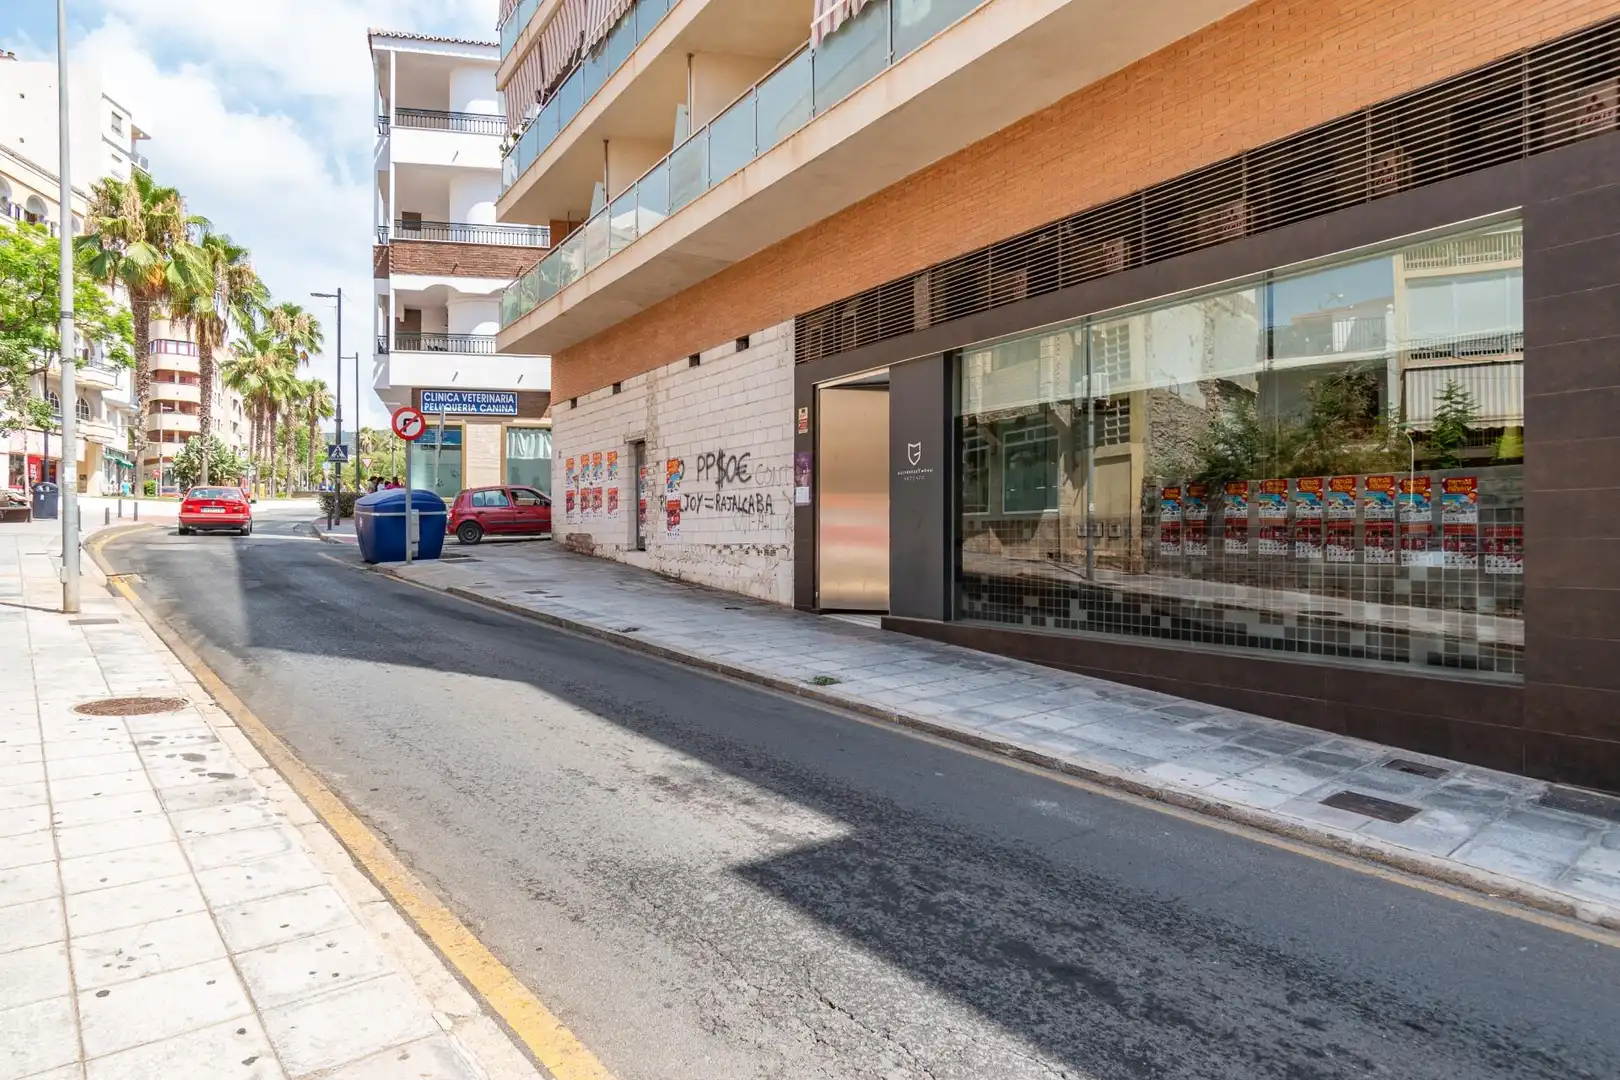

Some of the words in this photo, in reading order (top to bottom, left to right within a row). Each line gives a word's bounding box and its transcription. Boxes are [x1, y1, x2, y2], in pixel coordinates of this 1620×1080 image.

[424, 392, 460, 403] CLINICA
[462, 393, 515, 404] VETERINARIA
[479, 404, 515, 413] CANINA
